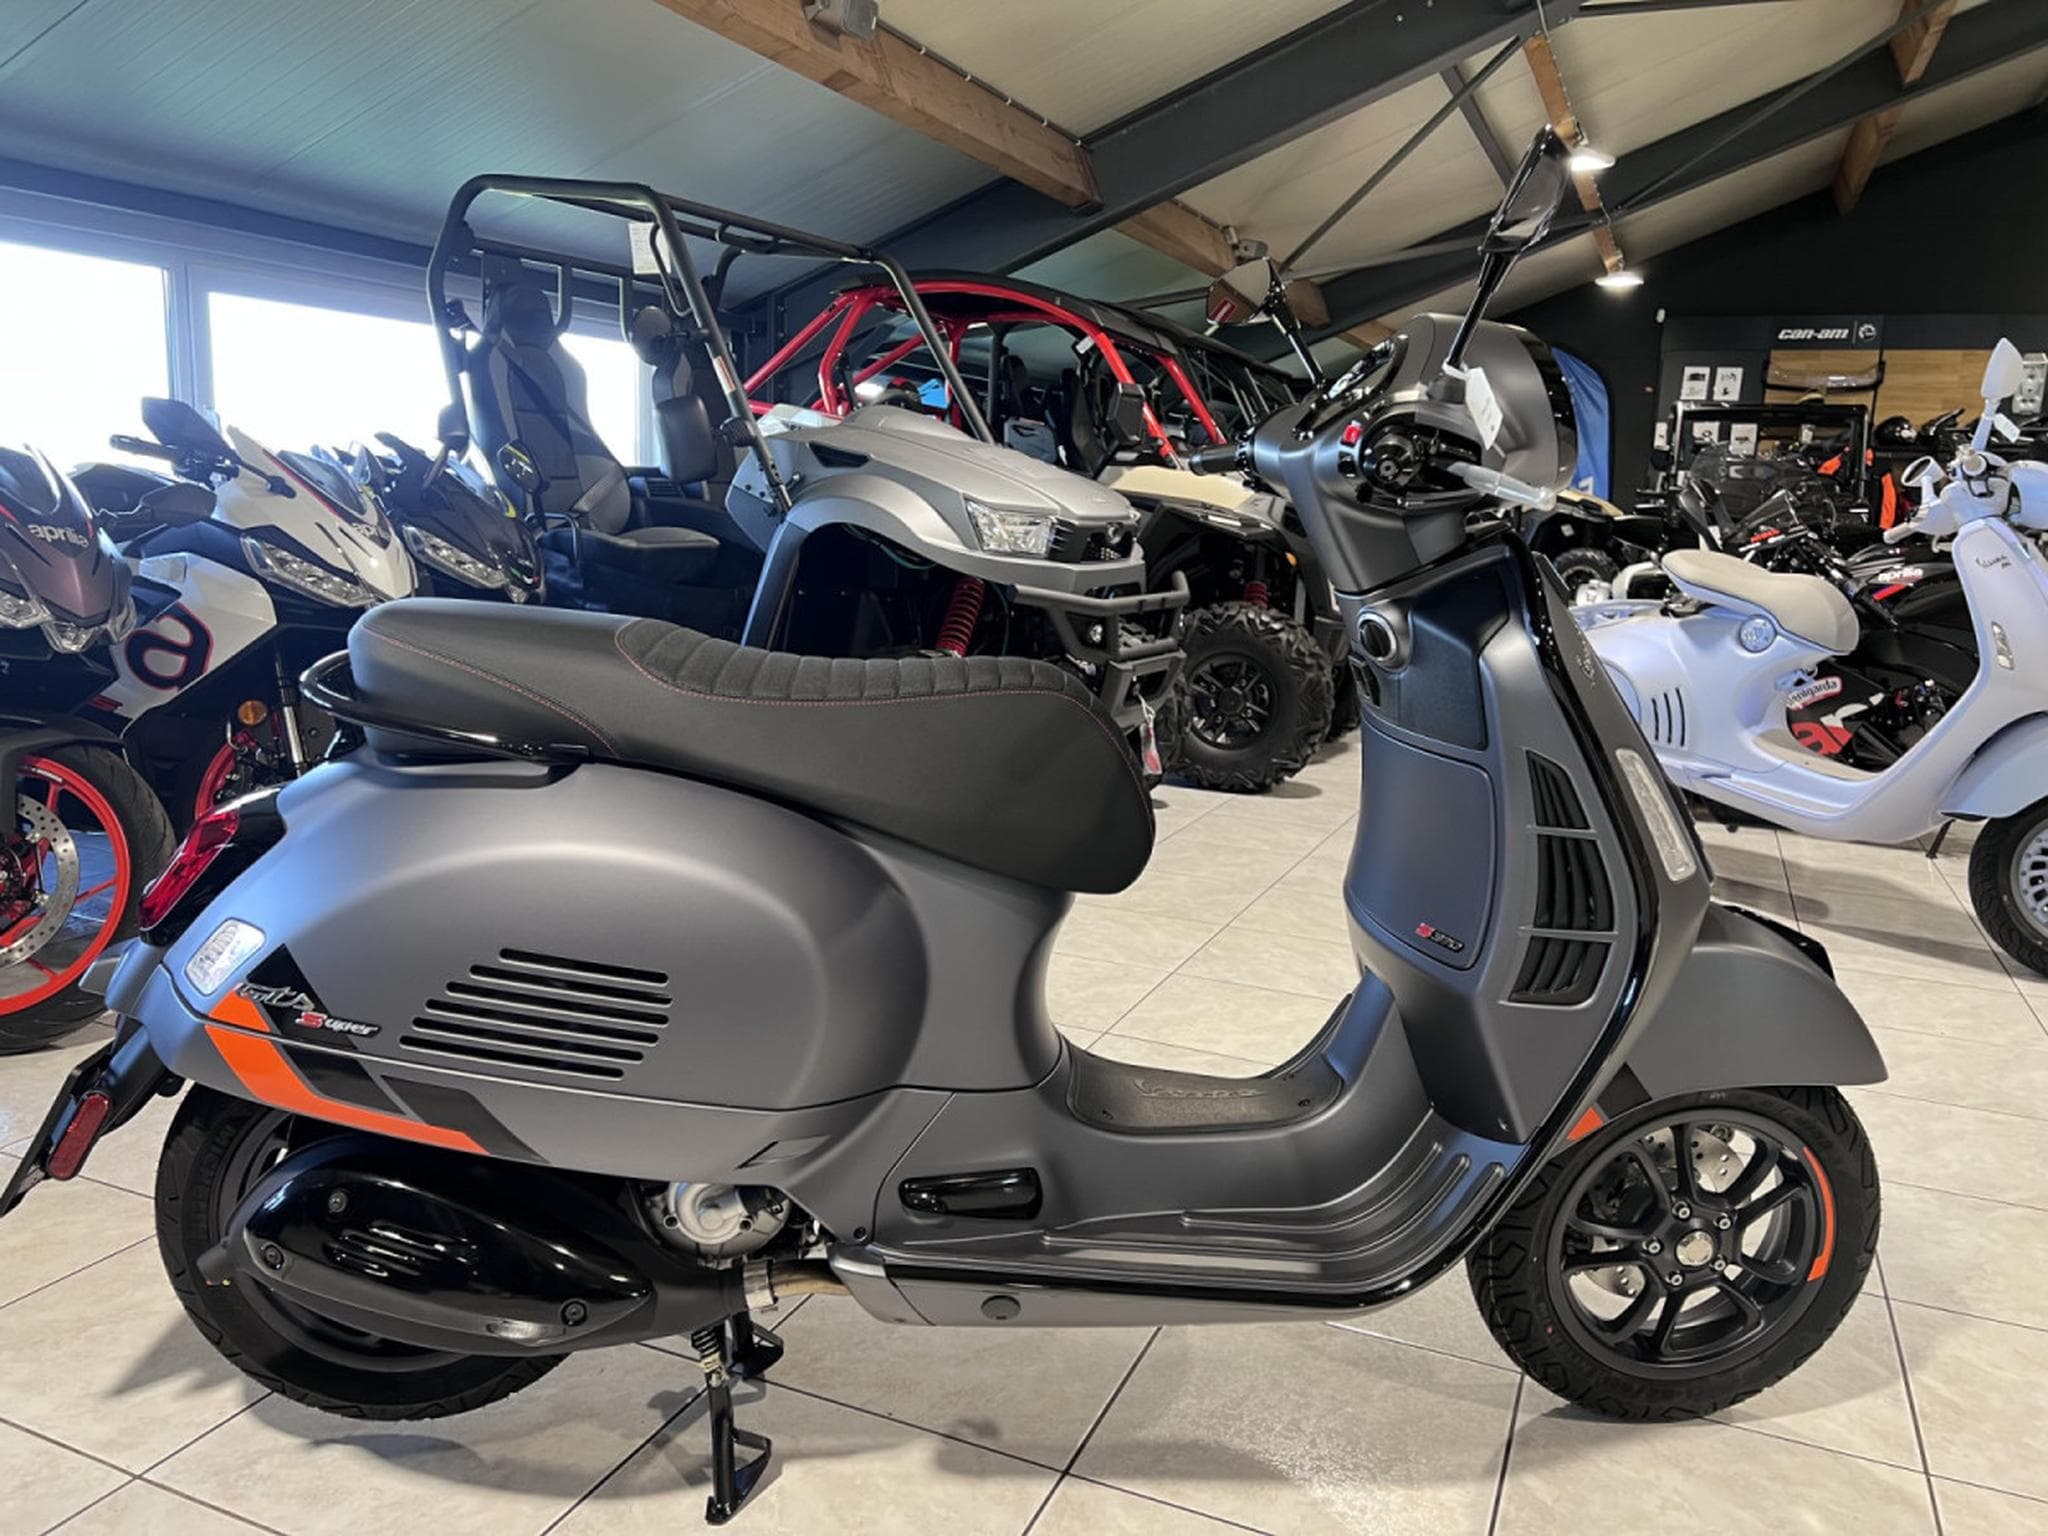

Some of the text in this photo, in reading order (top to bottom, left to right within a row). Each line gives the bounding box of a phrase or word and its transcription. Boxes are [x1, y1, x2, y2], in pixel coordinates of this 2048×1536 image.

[1778, 328, 1849, 340] can-am
[27, 523, 88, 549] aprilia
[295, 1011, 379, 1035] Super
